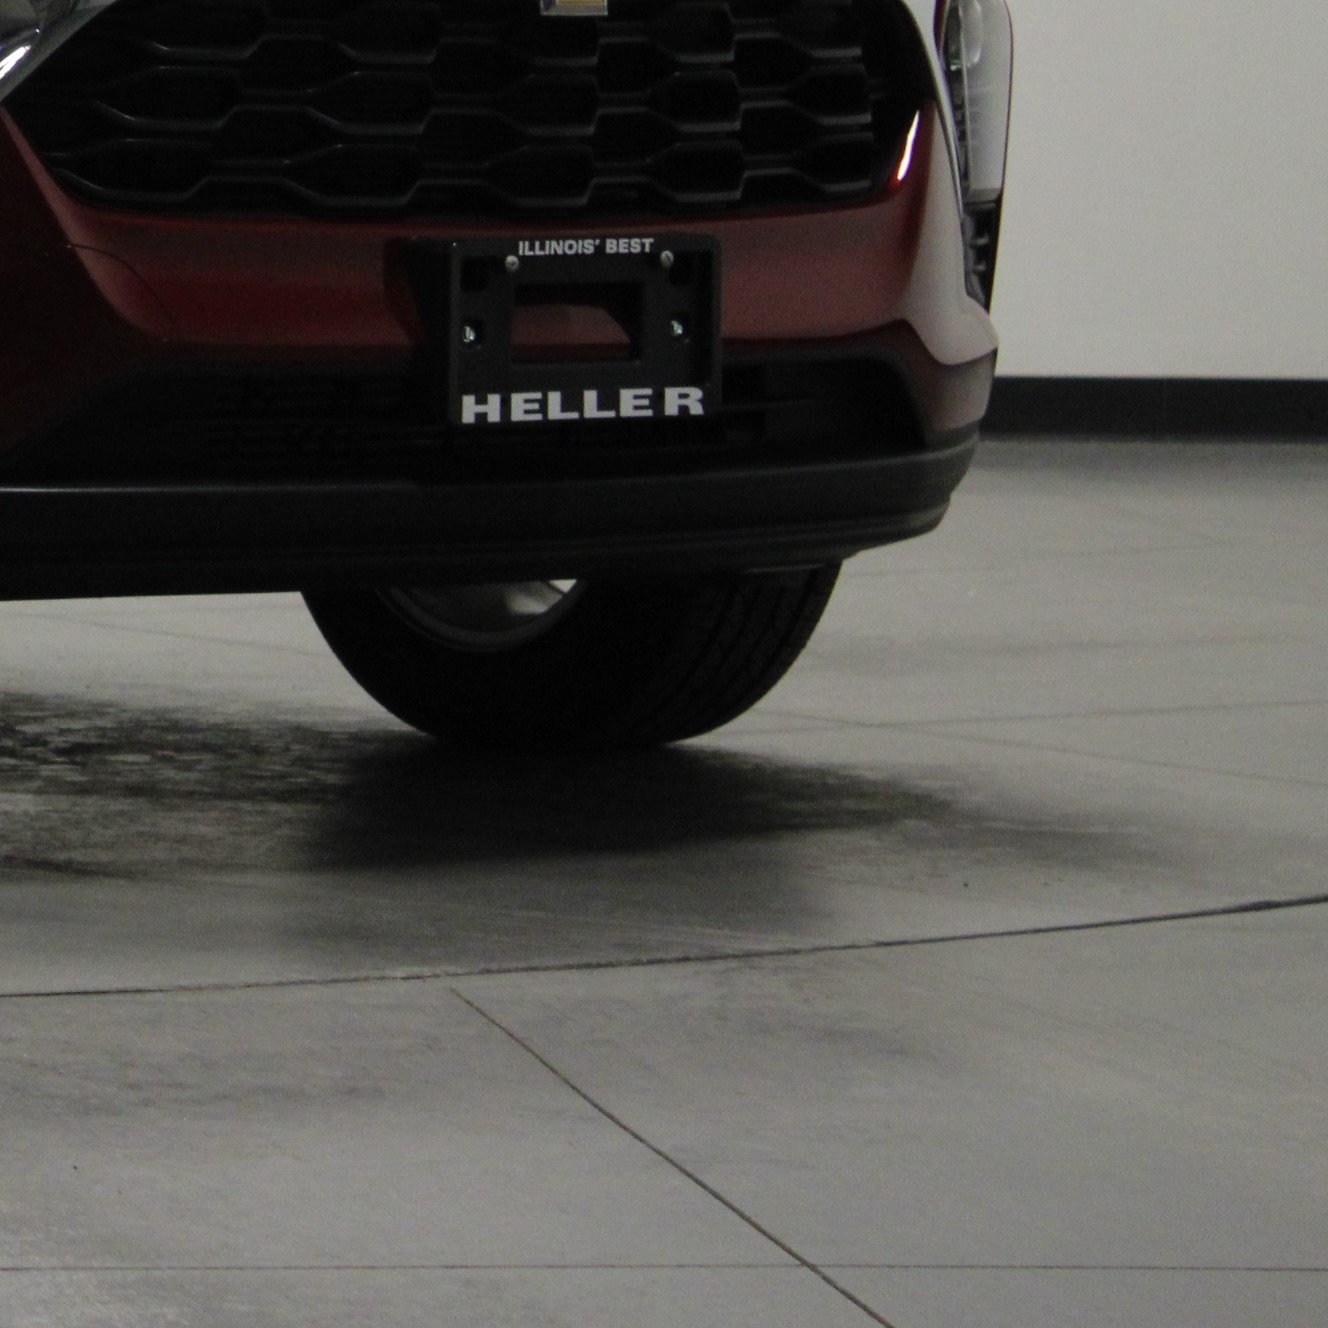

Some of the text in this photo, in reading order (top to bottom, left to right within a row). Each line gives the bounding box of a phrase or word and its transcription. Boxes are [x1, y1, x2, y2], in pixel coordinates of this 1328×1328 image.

[518, 237, 655, 256] ILLINOIS' BEST
[461, 386, 705, 424] HELLER
